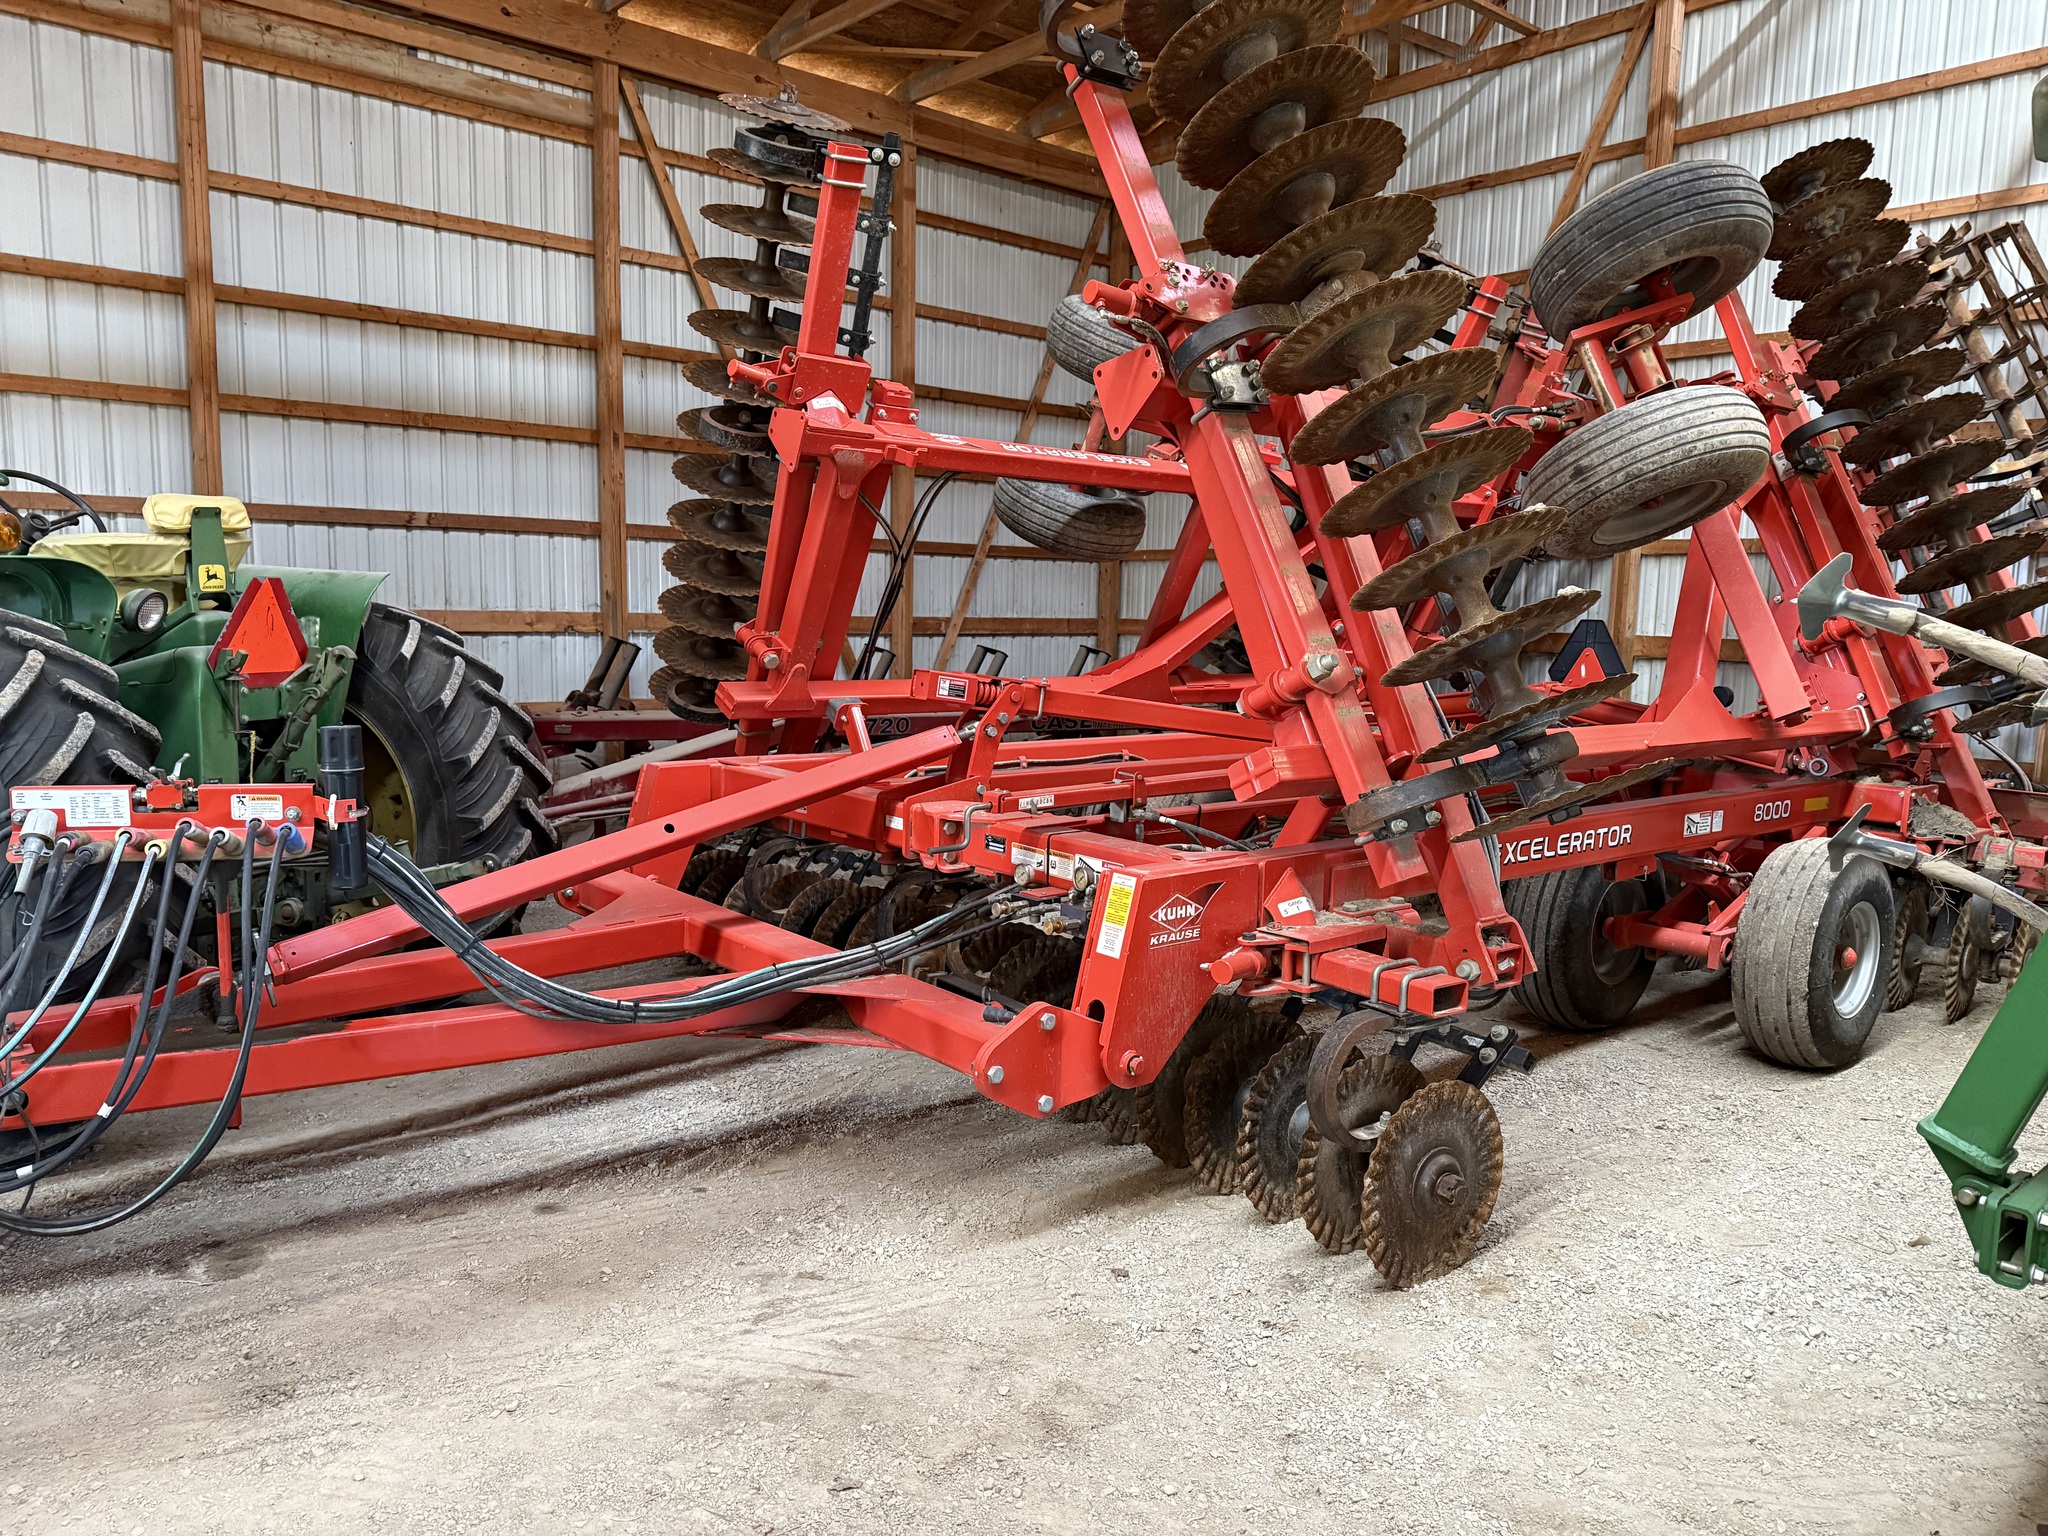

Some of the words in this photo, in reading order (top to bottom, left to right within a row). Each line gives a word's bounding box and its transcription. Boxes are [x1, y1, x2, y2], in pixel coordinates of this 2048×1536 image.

[999, 442, 1152, 467] EXCELERATOR
[1031, 716, 1092, 730] CASE
[1753, 799, 1792, 822] 8000
[1158, 904, 1196, 922] KUHN
[1150, 928, 1201, 946] KRAUSE
